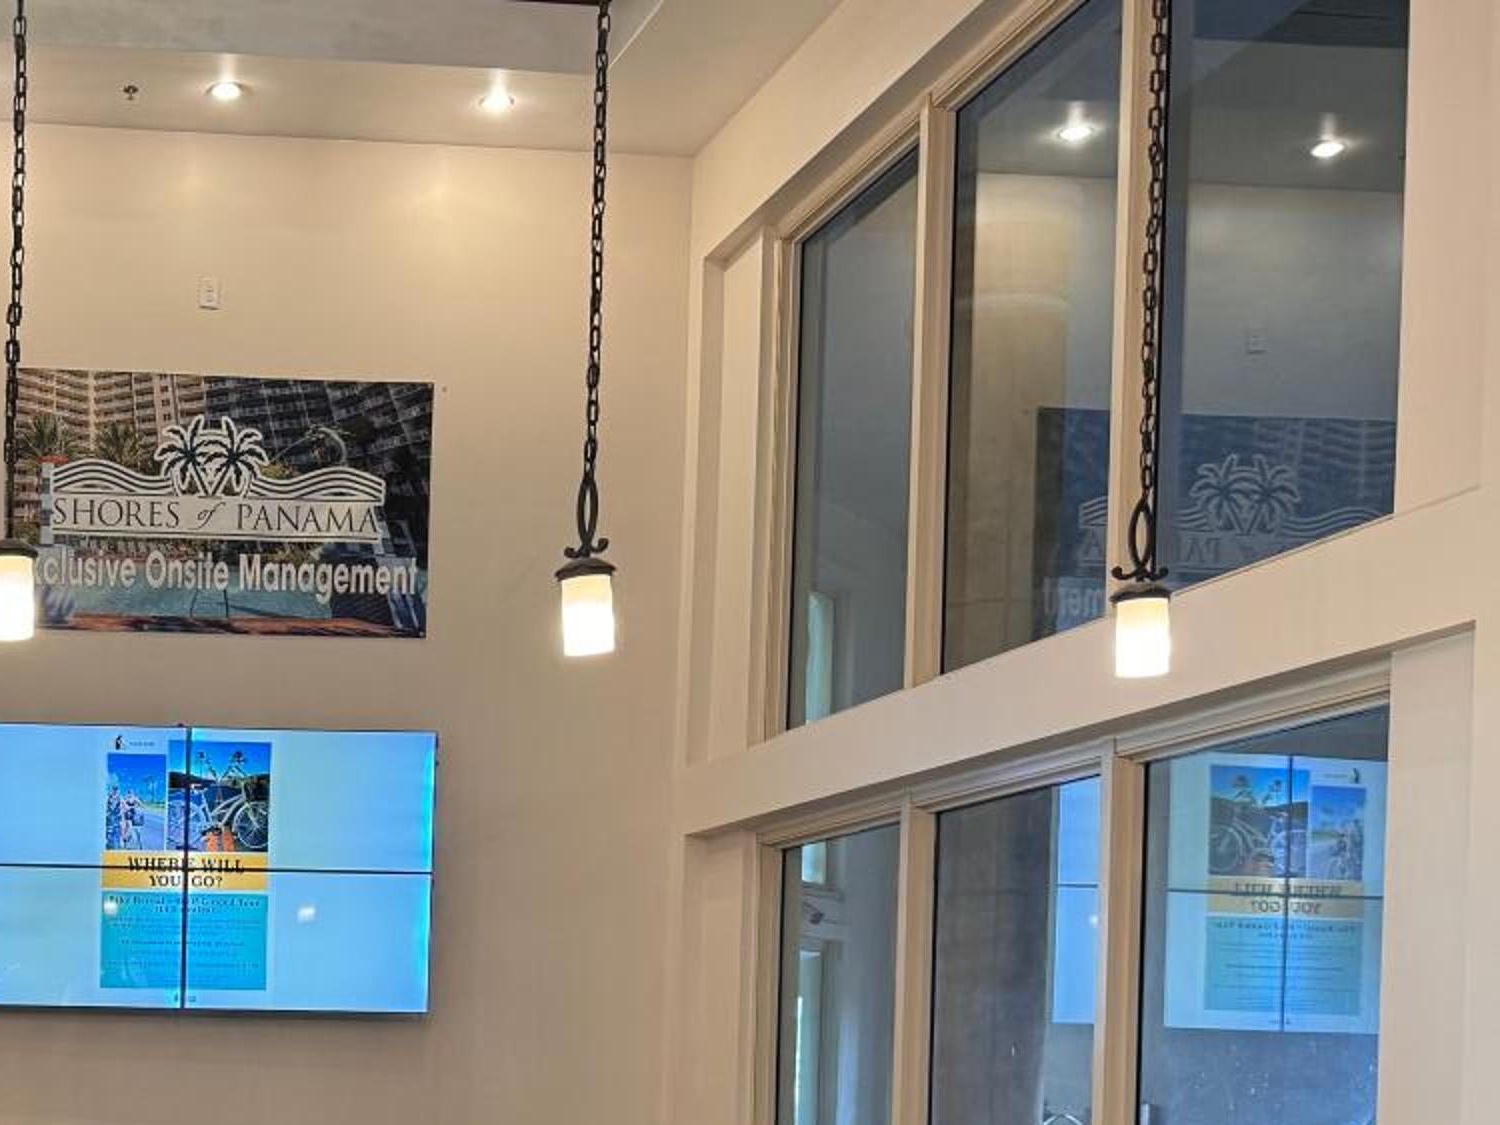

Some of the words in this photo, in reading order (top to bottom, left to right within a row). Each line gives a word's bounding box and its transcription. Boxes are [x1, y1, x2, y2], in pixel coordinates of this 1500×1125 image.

[52, 497, 180, 529] SHORES
[194, 501, 226, 532] of
[236, 503, 379, 535] PANAMA
[35, 547, 137, 588] clusive
[146, 551, 229, 590] Onsite
[239, 553, 419, 601] Management
[128, 857, 195, 872] WHERE
[149, 874, 182, 888] YOU
[191, 875, 223, 888] GO?
